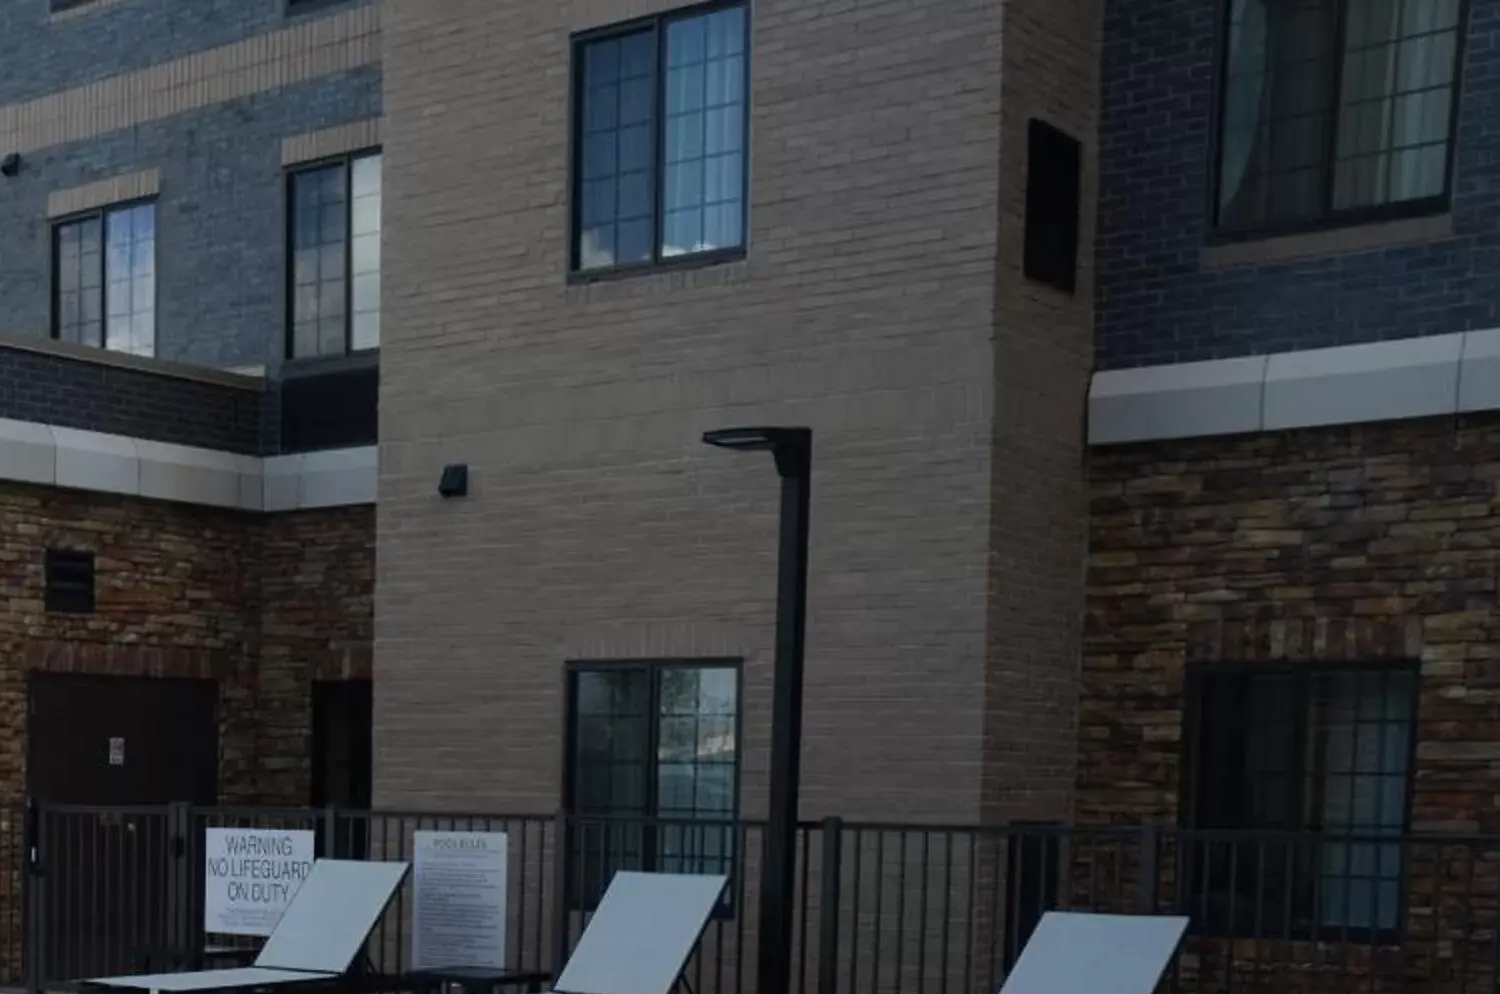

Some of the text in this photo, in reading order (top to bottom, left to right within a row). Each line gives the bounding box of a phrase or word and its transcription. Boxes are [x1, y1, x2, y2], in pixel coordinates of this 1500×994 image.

[225, 835, 293, 857] WARNING
[208, 858, 311, 880] NO LIFEGUARD
[227, 881, 288, 902] ON DUTY
